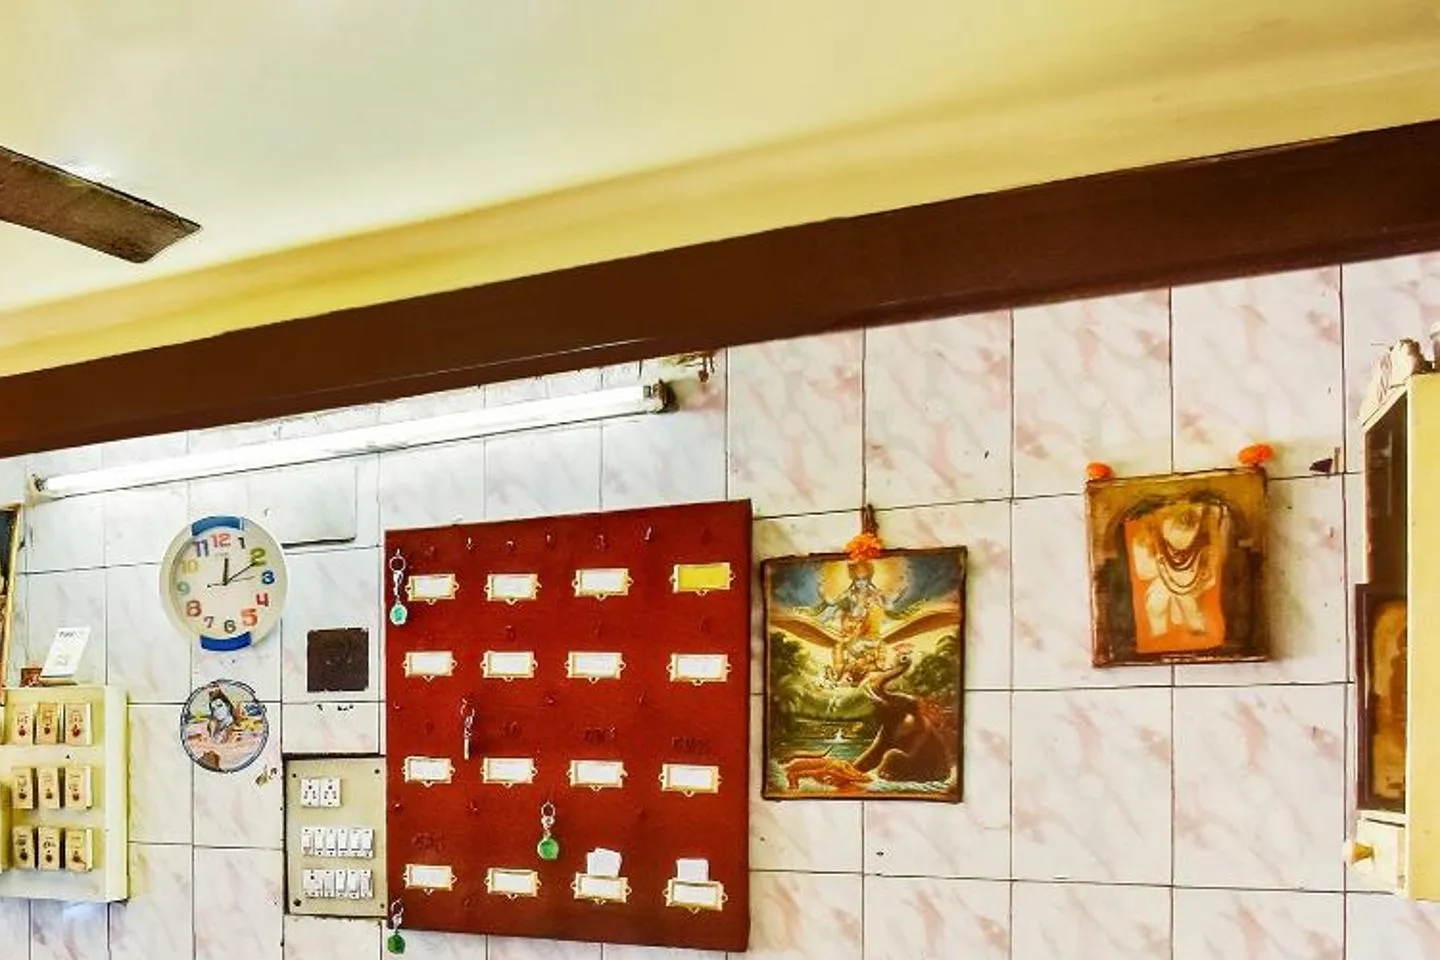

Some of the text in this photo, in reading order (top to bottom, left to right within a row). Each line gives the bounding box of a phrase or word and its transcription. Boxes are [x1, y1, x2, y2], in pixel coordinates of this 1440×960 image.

[211, 533, 231, 548] 12
[238, 537, 245, 549] 1
[193, 539, 208, 557] 11
[250, 547, 266, 566] 2
[182, 559, 198, 573] 10
[262, 570, 275, 584] 3
[176, 582, 190, 595] 9
[256, 592, 269, 607] 4
[186, 600, 201, 617] 8
[204, 616, 213, 628] 7
[241, 608, 257, 626] 5
[224, 619, 236, 633] 6
